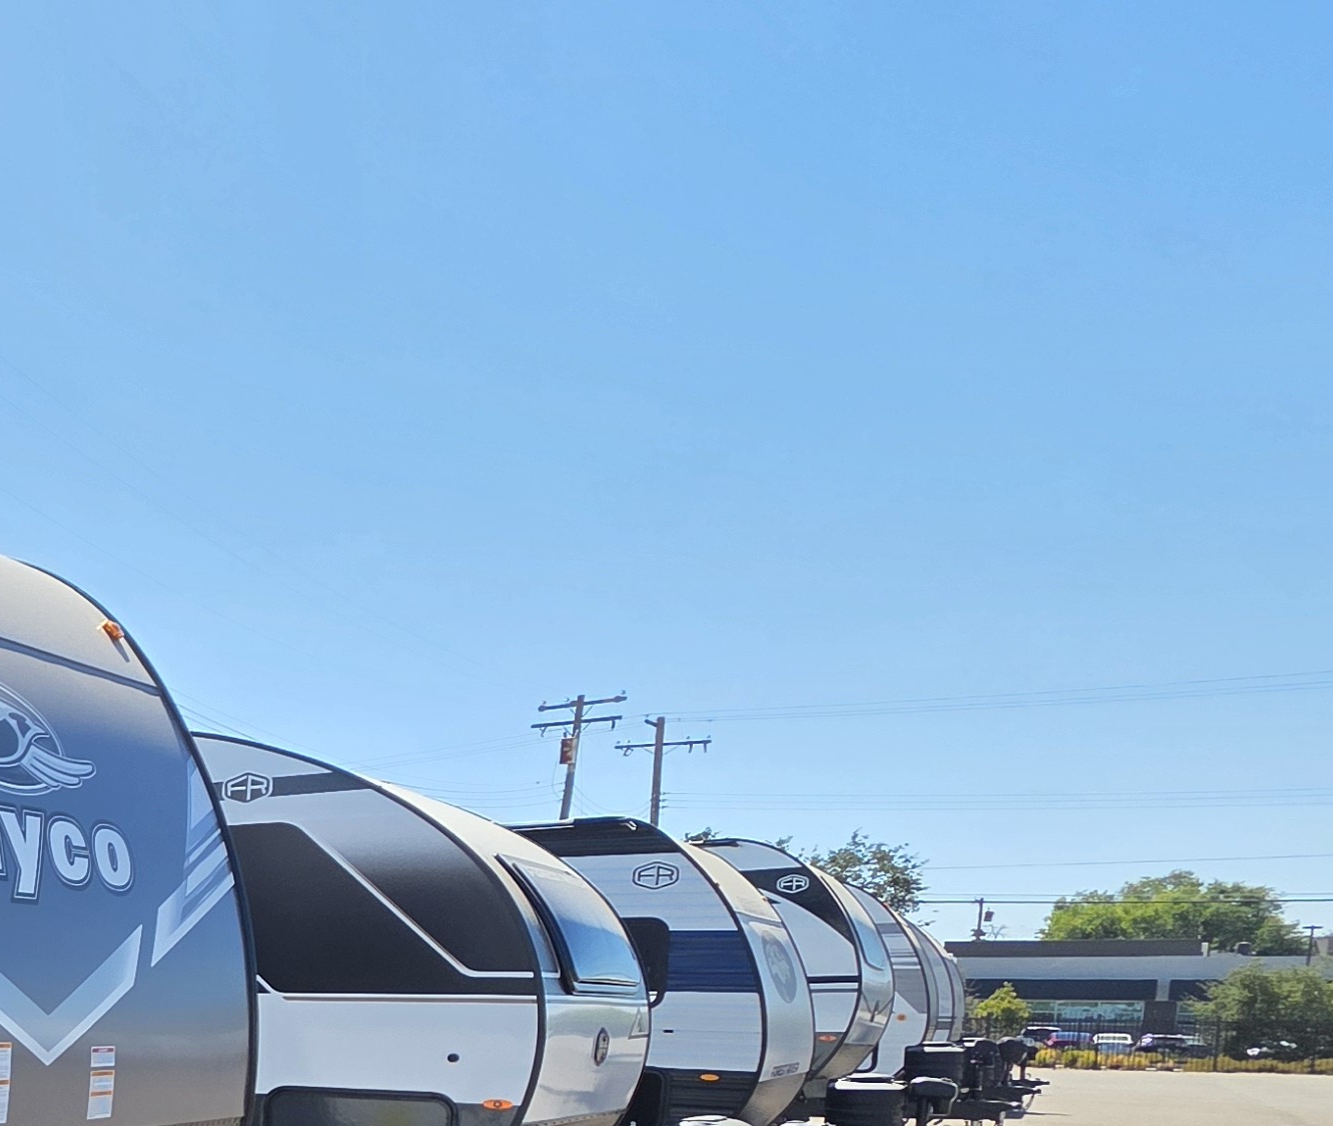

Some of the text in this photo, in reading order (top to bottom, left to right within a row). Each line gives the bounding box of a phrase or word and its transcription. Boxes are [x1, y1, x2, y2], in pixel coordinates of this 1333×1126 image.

[225, 773, 269, 802] FR
[636, 864, 676, 886] FR
[780, 876, 807, 891] FR
